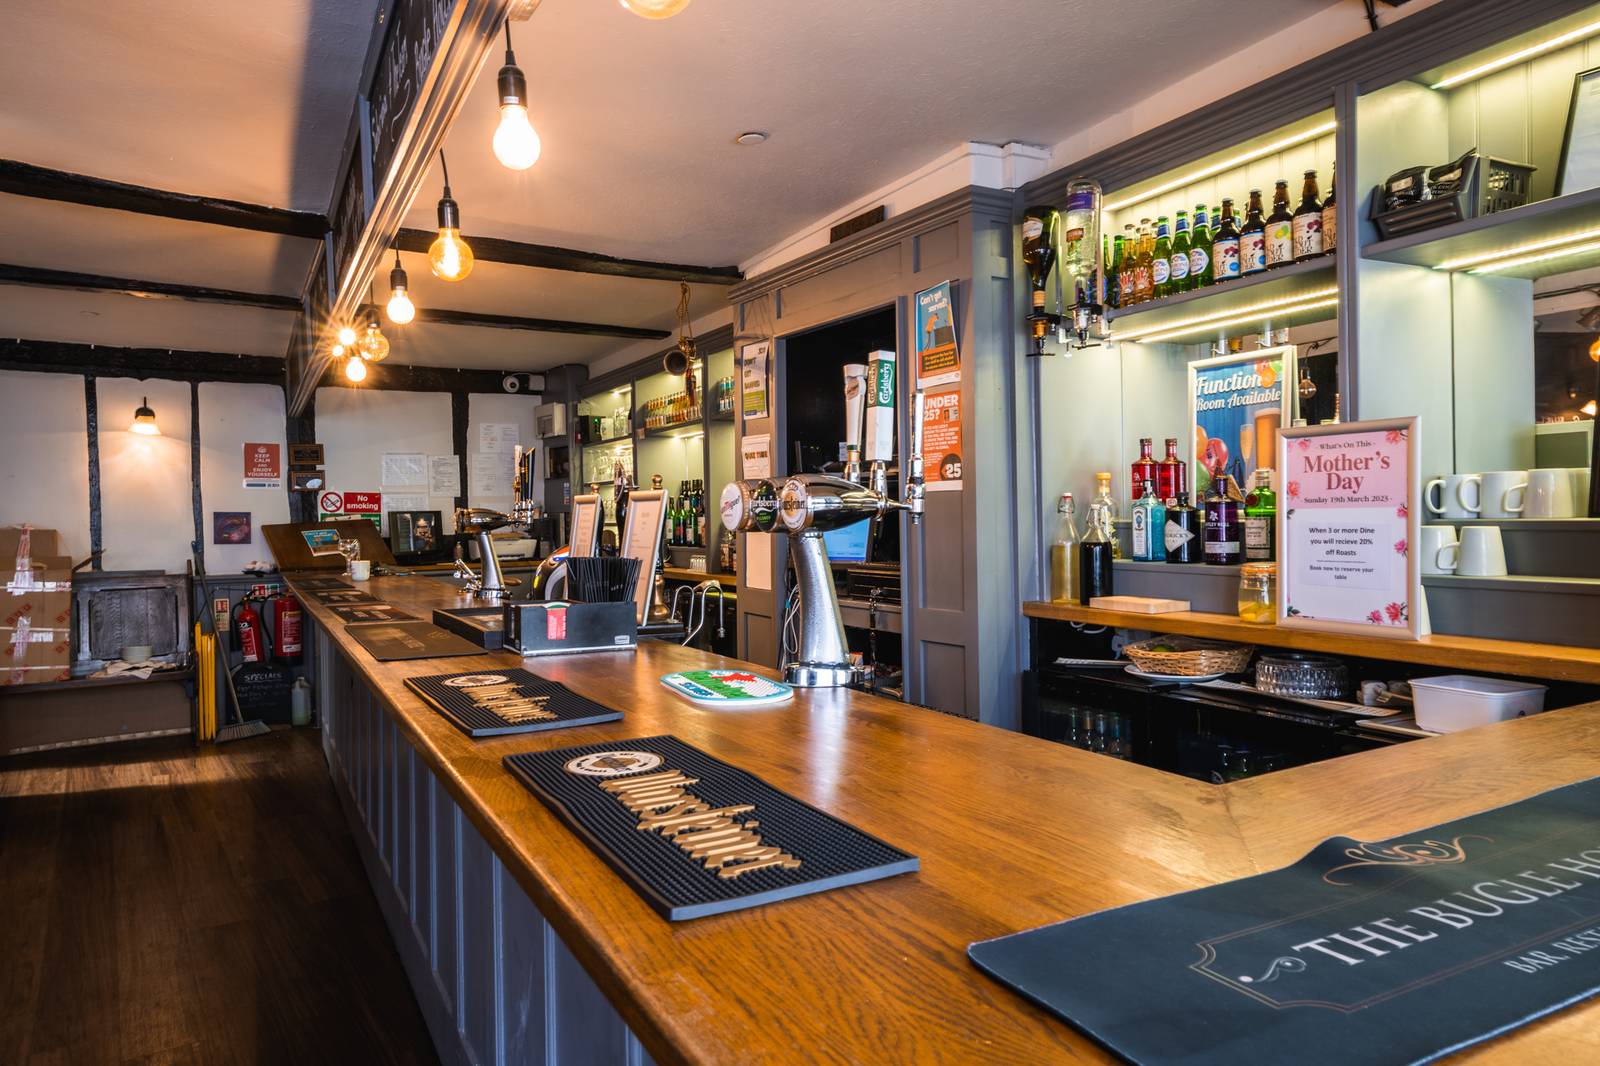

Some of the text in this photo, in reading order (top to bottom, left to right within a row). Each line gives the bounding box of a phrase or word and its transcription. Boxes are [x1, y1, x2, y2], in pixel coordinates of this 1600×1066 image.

[920, 293, 934, 305] Can't
[928, 298, 948, 312] served?
[879, 363, 893, 404] Carlsberg
[1196, 371, 1262, 396] Function
[924, 394, 959, 410] UNDER
[1196, 388, 1281, 412] Room Available
[924, 408, 940, 421] 25?
[1320, 442, 1341, 450] What's
[1303, 451, 1391, 473] Mother's
[946, 463, 962, 478] 25
[1326, 472, 1364, 494] Day
[346, 503, 379, 511] smoking
[1303, 496, 1328, 504] Sunday
[1330, 495, 1346, 503] 19th
[1347, 495, 1370, 503] March
[1292, 917, 1438, 967] THE
[1409, 870, 1583, 930] BUGLE
